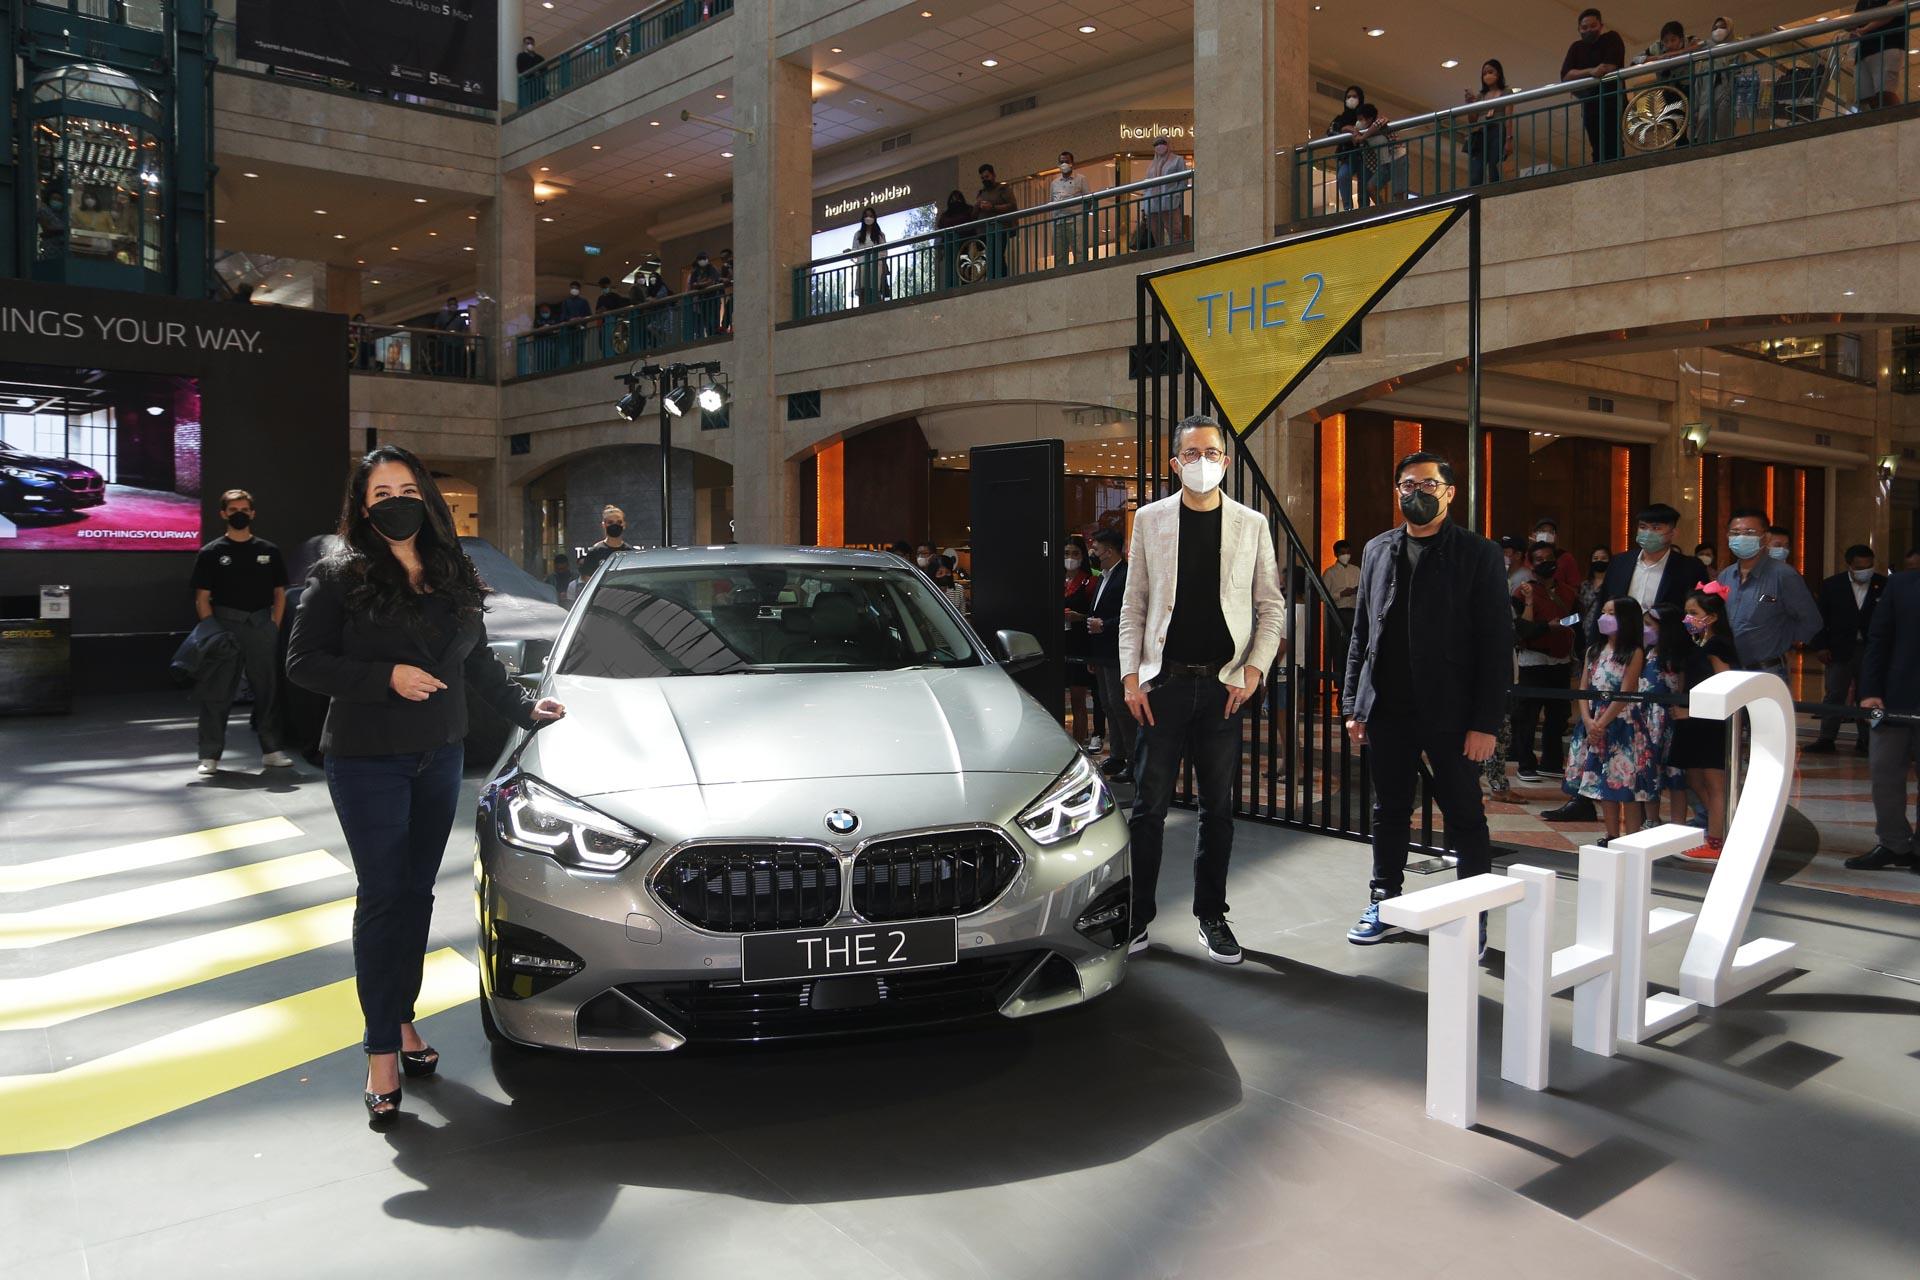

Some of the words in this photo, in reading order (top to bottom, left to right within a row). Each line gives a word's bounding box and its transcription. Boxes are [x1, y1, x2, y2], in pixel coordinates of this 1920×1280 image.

[442, 5, 450, 15] 5
[1120, 123, 1184, 139] harlan
[825, 199, 860, 217] harlan
[870, 184, 911, 204] holden
[1197, 279, 1287, 337] THE
[1301, 272, 1325, 322] 2
[2, 306, 84, 338] INGS
[93, 315, 187, 347] YOUR
[195, 325, 263, 353] WAY.
[77, 529, 199, 539] #DOTHINGSYOURWAY
[1378, 823, 1705, 1129] THE
[1678, 670, 1798, 1008] 2
[796, 933, 877, 970] THE
[887, 931, 908, 963] 2
